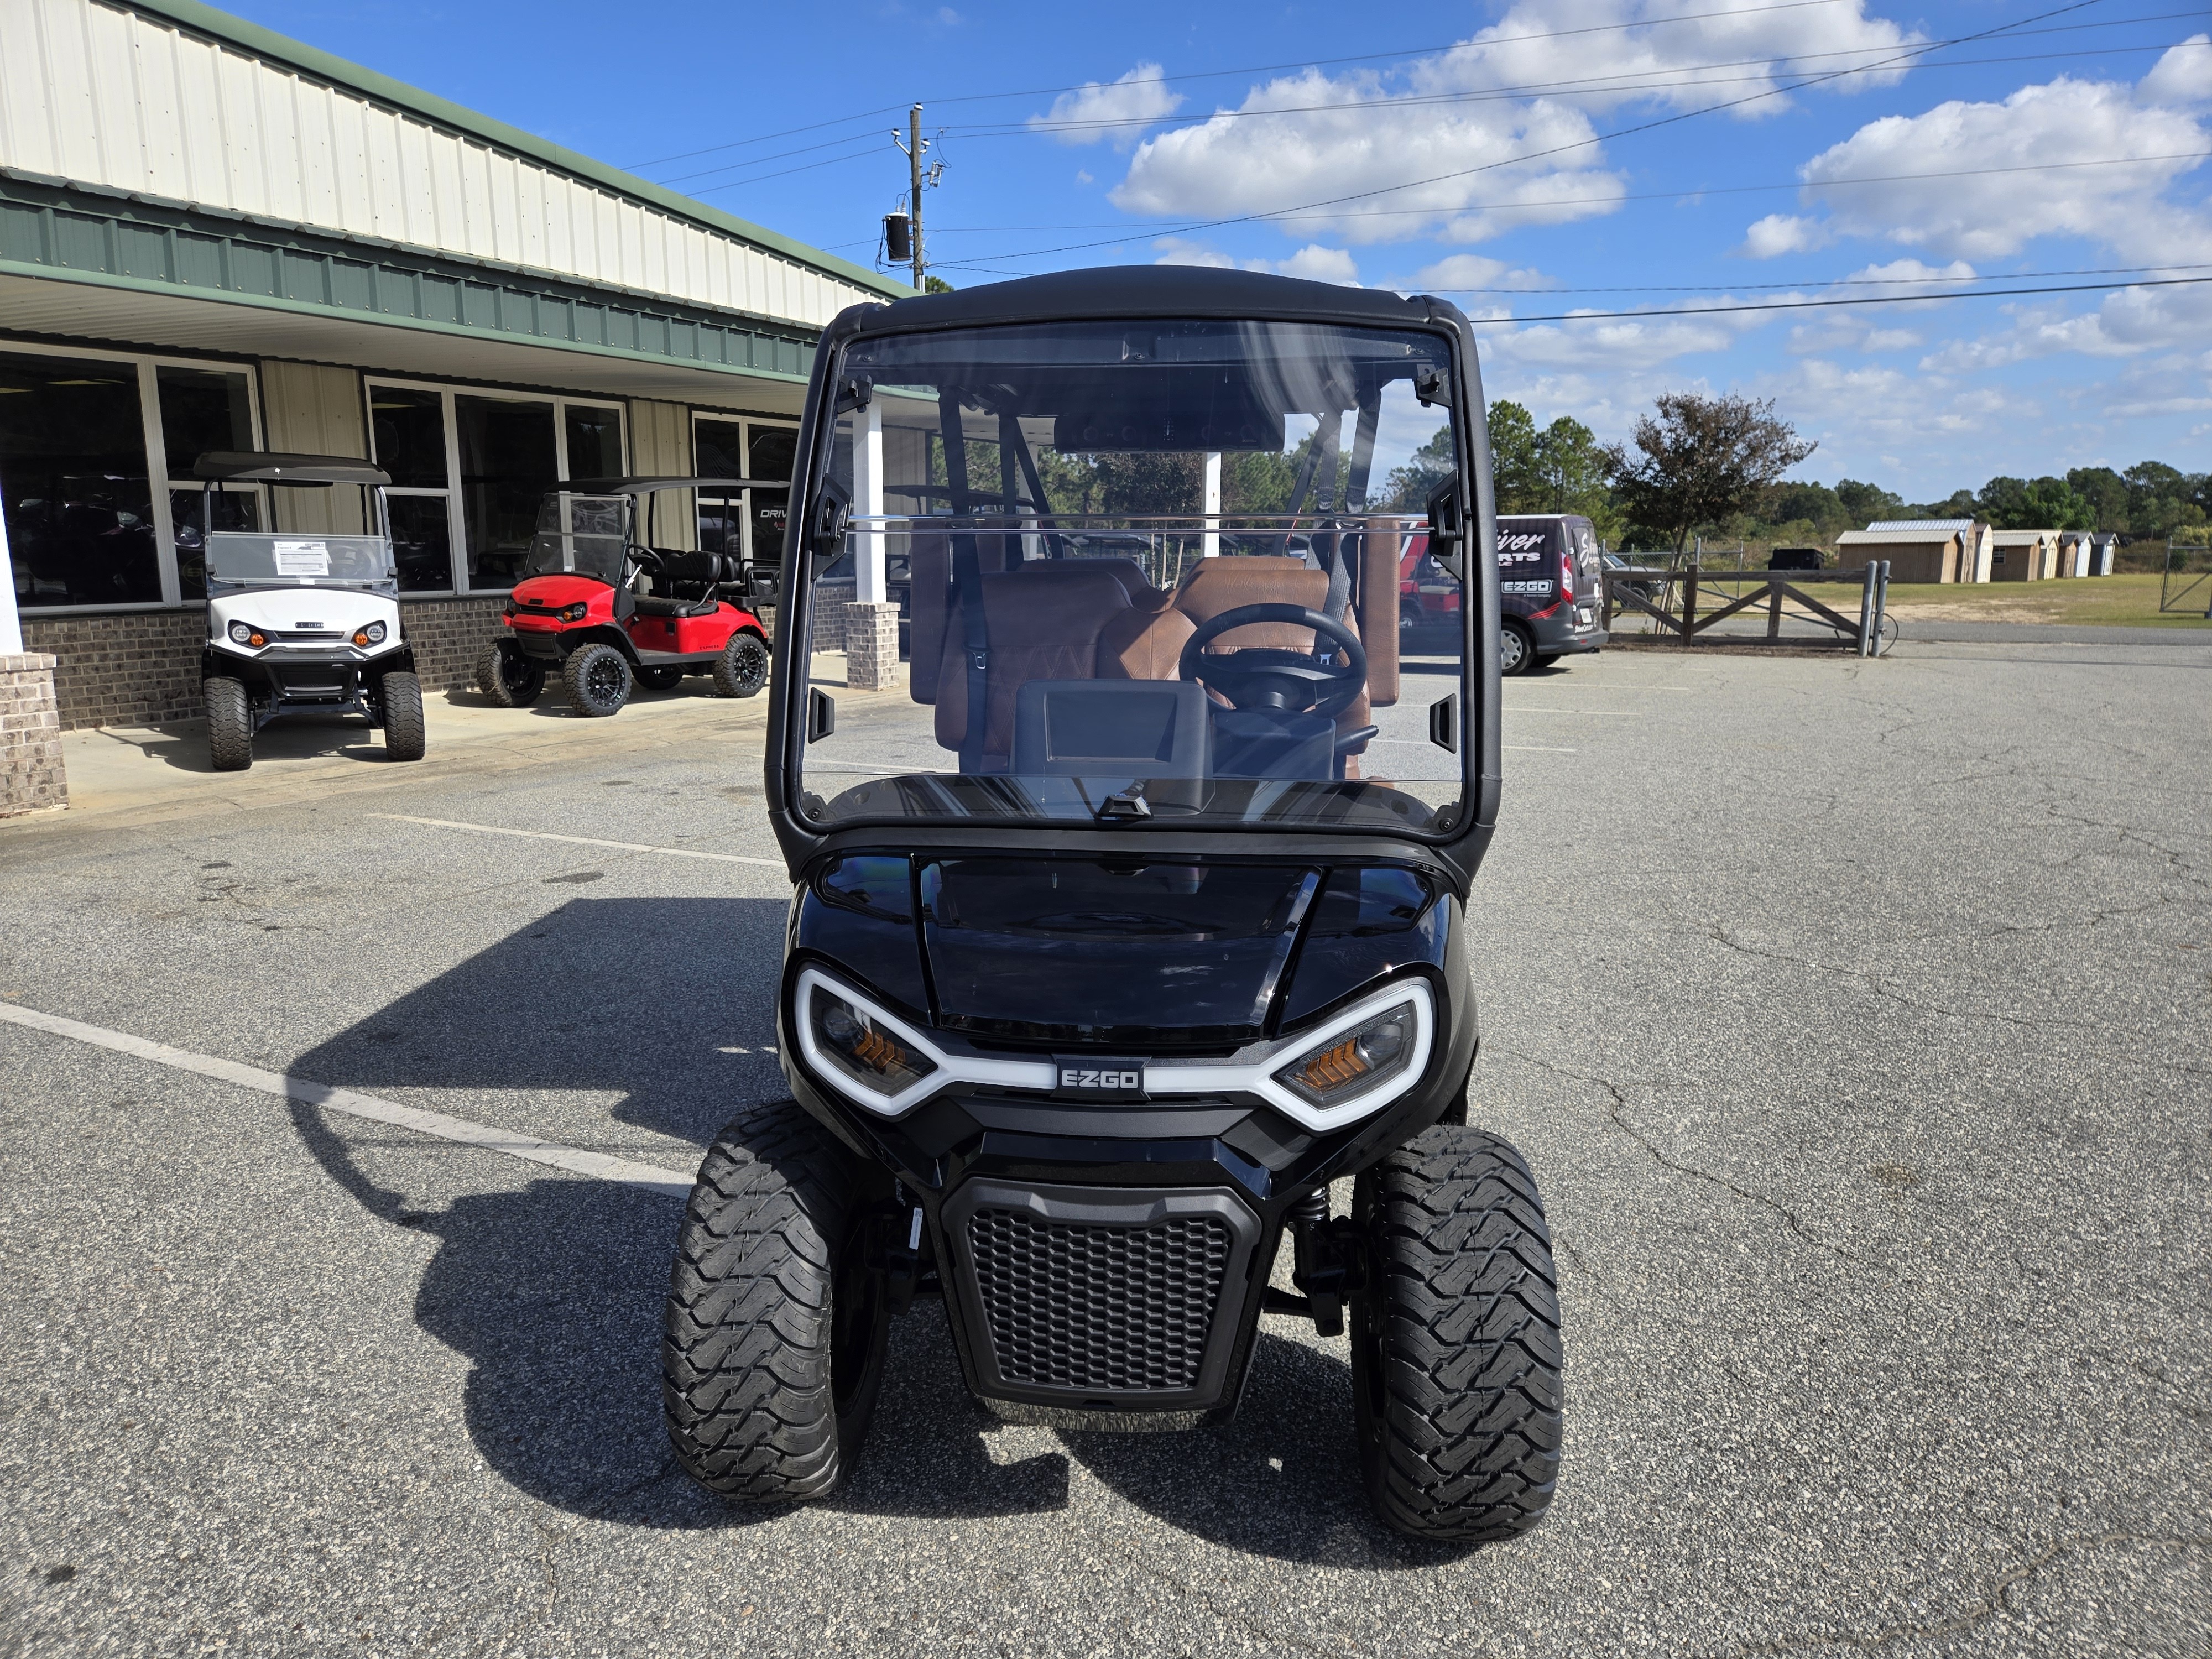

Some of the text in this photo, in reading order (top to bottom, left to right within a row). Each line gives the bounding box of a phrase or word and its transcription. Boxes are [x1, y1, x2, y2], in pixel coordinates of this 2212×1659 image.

[760, 509, 787, 518] DRIV
[1498, 552, 1541, 561] RTS
[1504, 581, 1550, 591] EZGO
[1062, 1070, 1139, 1088] EZGO
